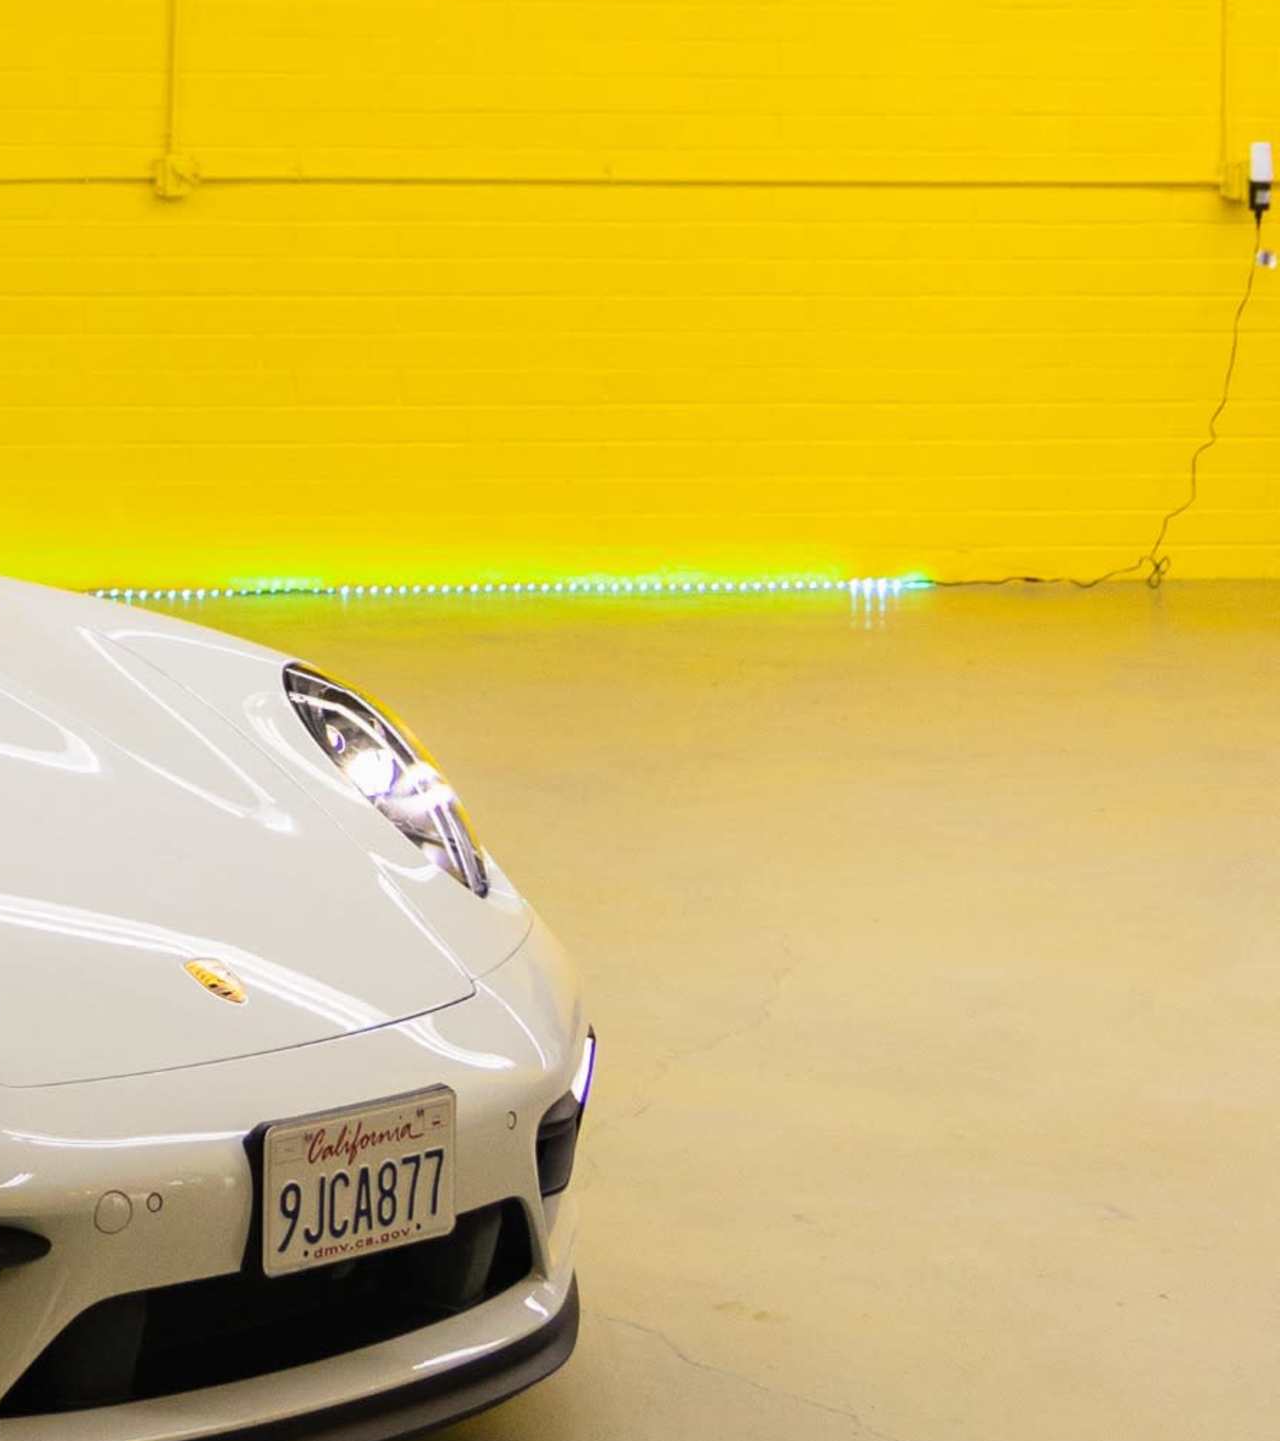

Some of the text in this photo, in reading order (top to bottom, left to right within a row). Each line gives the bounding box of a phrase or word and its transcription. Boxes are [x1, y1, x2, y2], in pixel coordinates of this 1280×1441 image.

[307, 1115, 424, 1166] California
[277, 1148, 444, 1253] 9JCA877
[313, 1227, 411, 1259] dmv.ca.gov
